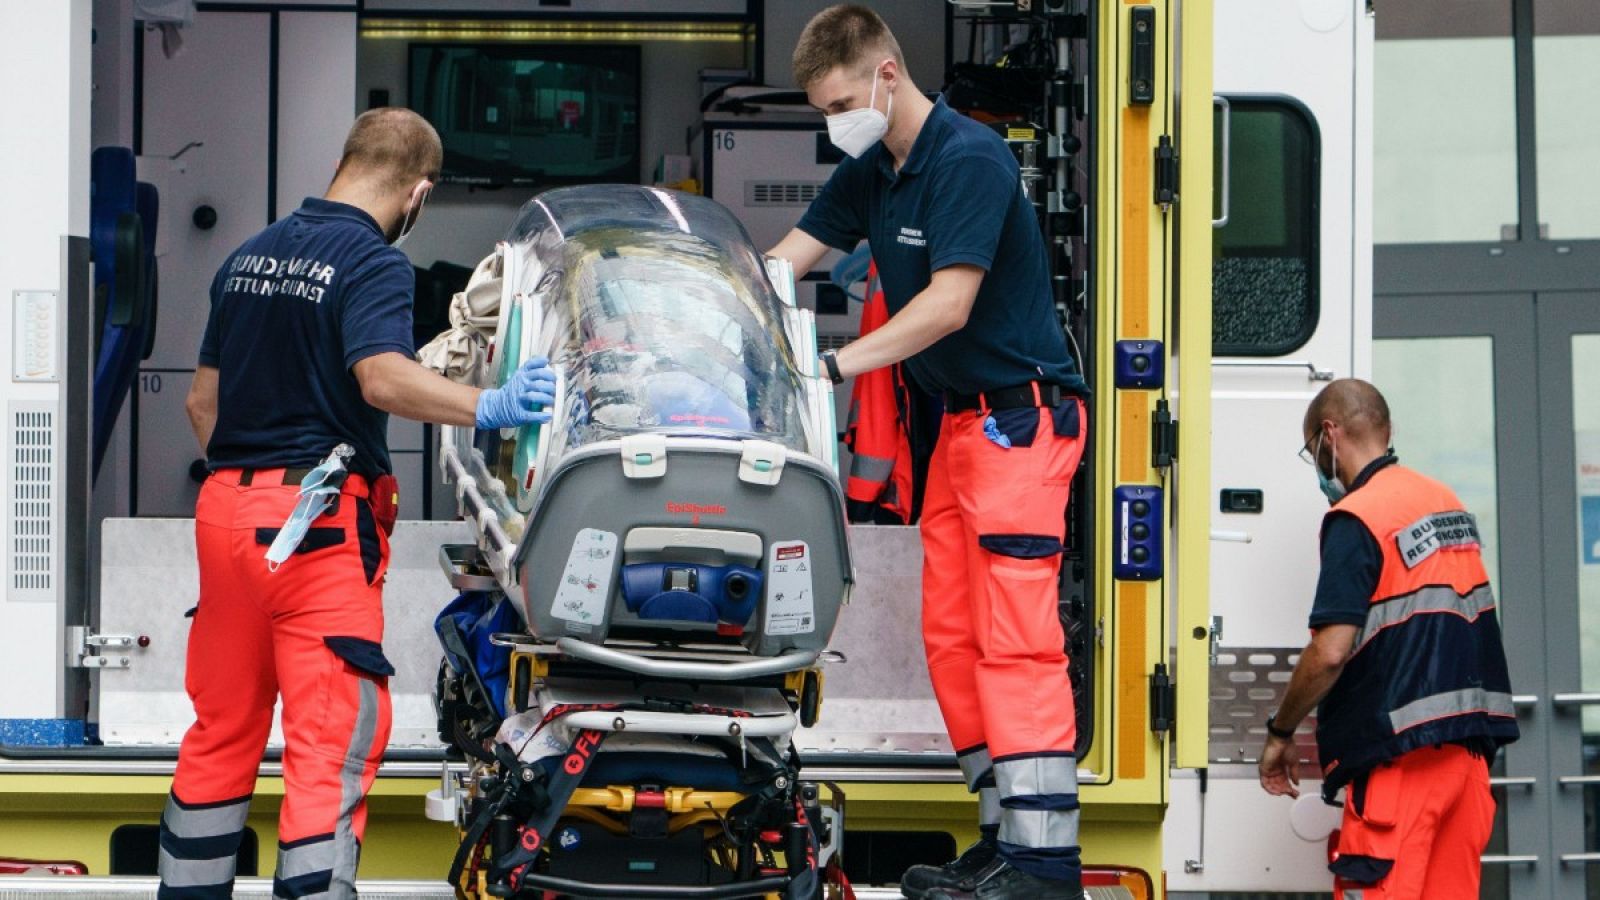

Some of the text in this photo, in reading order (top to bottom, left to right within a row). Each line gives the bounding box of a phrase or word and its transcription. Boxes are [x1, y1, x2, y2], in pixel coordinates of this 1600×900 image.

[714, 131, 735, 151] 16
[230, 256, 335, 285] BUNDEWEHR
[141, 374, 161, 393] 10
